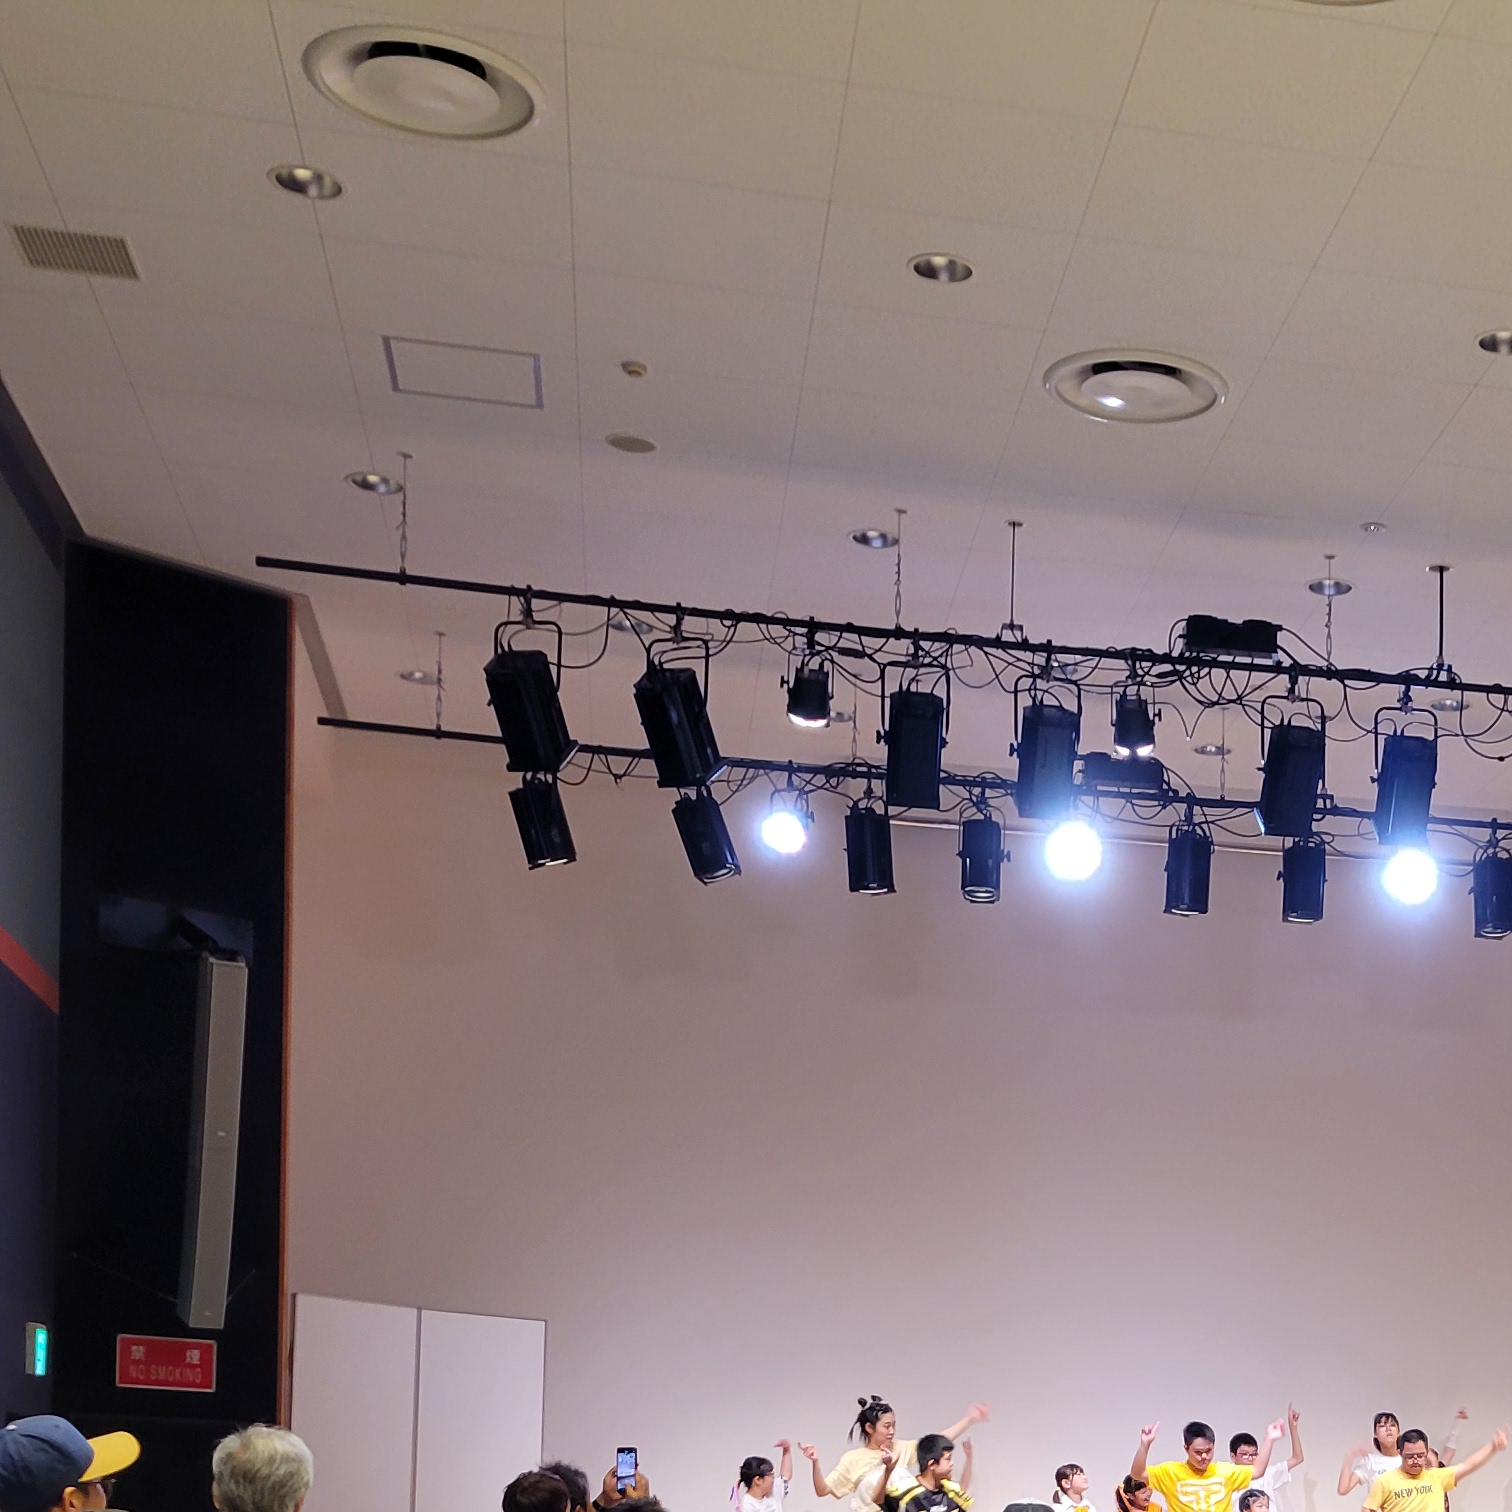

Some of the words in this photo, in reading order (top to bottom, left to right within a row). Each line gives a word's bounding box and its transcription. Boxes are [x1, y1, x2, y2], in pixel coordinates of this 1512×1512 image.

[129, 1365, 145, 1379] NO
[150, 1365, 201, 1383] SMOKING
[1394, 1488, 1413, 1500] NEW
[1414, 1485, 1433, 1495] YORK
